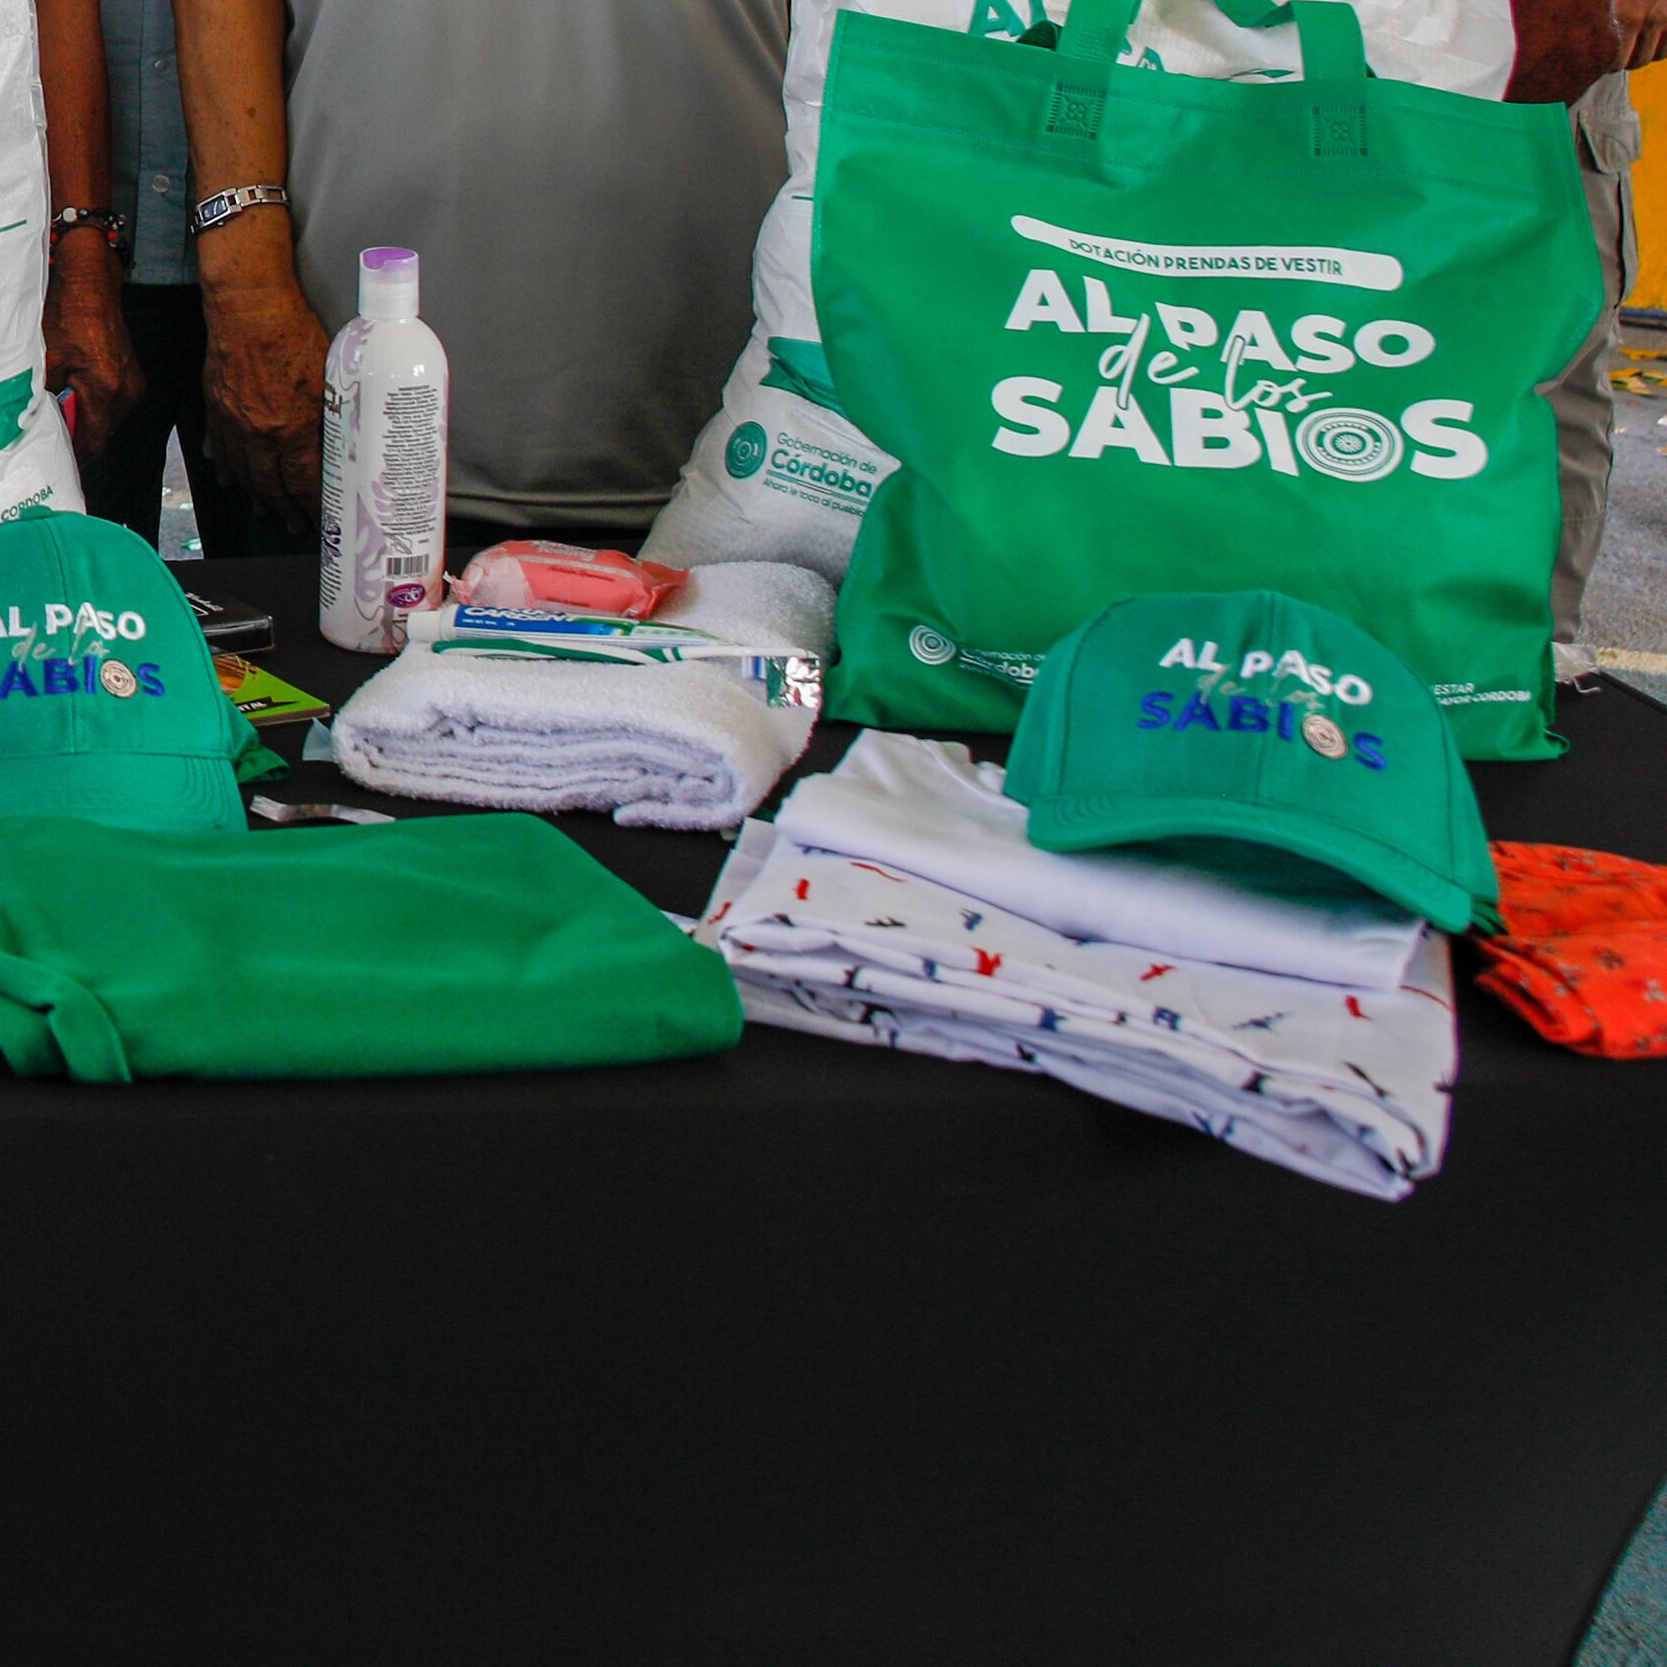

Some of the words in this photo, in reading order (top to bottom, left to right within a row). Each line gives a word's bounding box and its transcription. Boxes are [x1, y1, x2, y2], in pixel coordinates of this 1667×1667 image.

[1068, 237, 1160, 269] DOTACIÓN
[1164, 256, 1251, 271] PRENDAS
[1254, 256, 1278, 272] DE
[1281, 257, 1342, 276] VESTIR
[1004, 269, 1140, 334] AL
[1154, 301, 1436, 374] PASO
[1098, 313, 1199, 410] de
[990, 375, 1489, 482] SABIOS
[771, 448, 872, 497] Córdoba
[860, 461, 877, 474] de
[1159, 638, 1225, 671] AL
[1240, 650, 1373, 705] PASO
